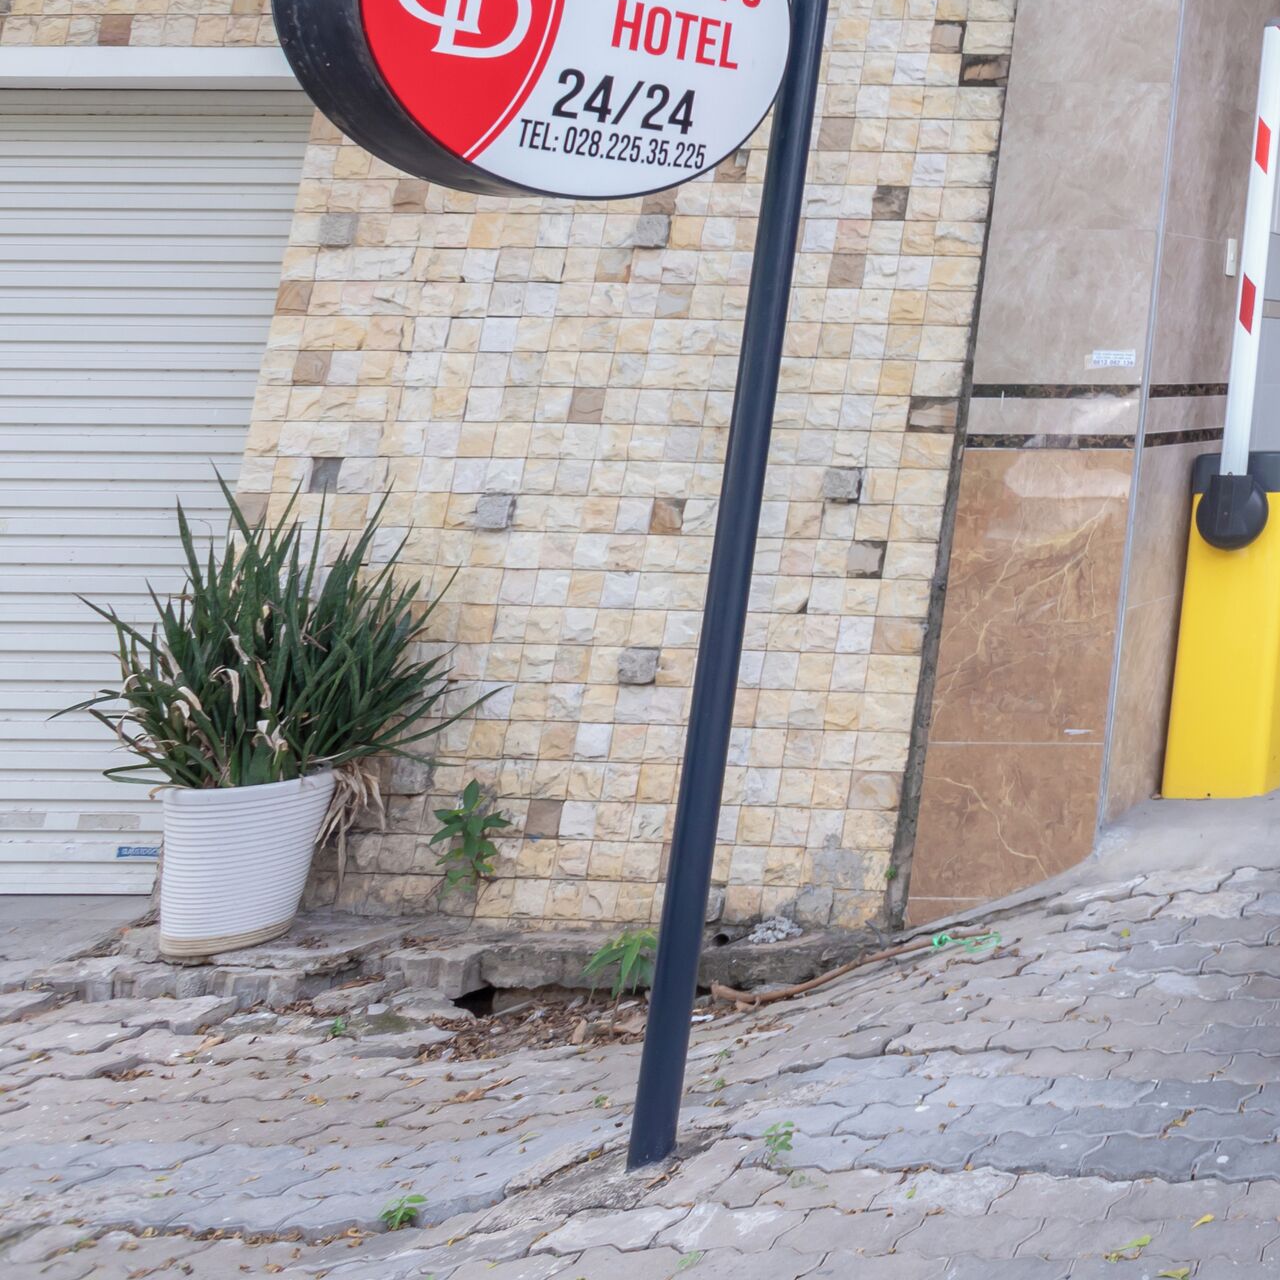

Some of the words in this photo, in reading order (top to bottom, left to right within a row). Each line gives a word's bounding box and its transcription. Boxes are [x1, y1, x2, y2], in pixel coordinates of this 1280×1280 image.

[552, 68, 695, 135] 24/24
[519, 119, 559, 152] TEL:
[563, 126, 707, 169] 028.225.35.225
